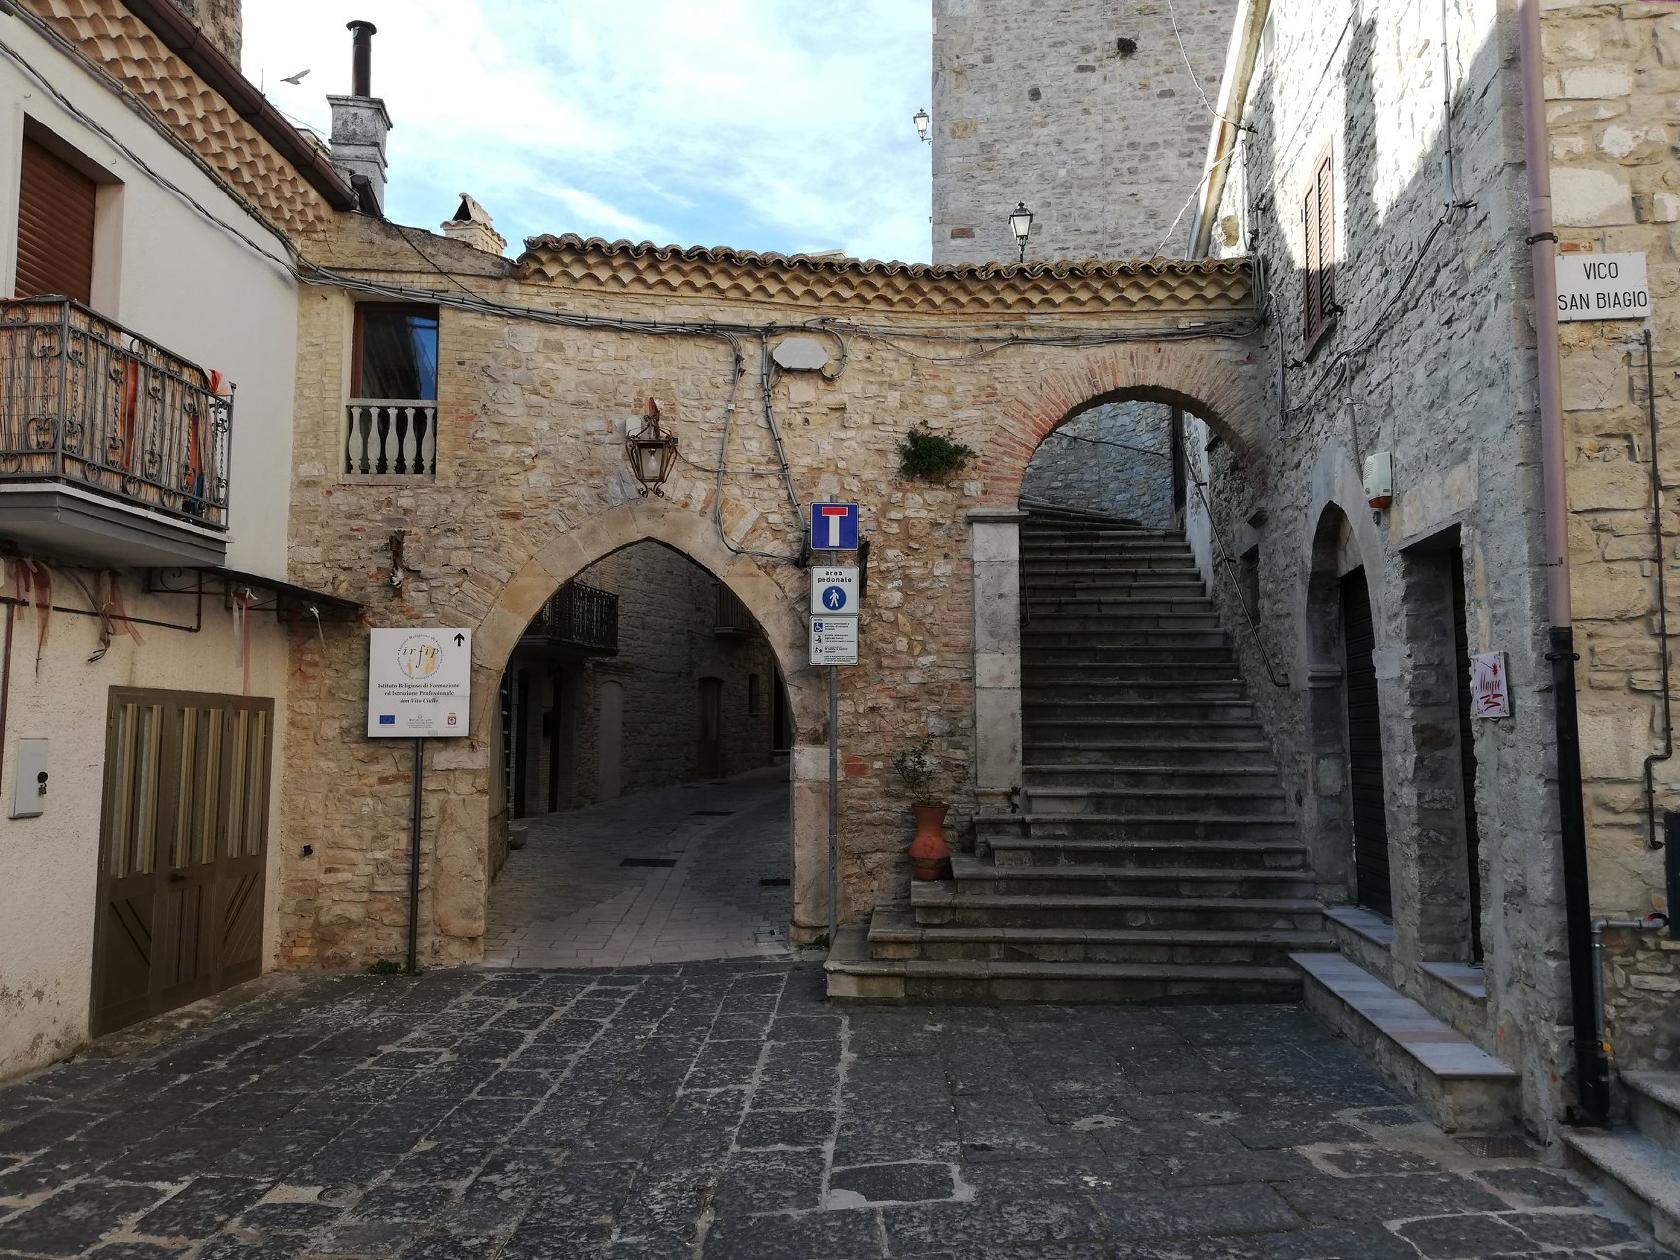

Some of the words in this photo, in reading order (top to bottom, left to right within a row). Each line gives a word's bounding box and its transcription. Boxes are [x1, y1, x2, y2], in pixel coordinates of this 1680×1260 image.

[1583, 262, 1619, 280] VICO
[1558, 293, 1590, 311] SAN
[1596, 291, 1648, 309] BIAGIO
[402, 644, 440, 669] irfip
